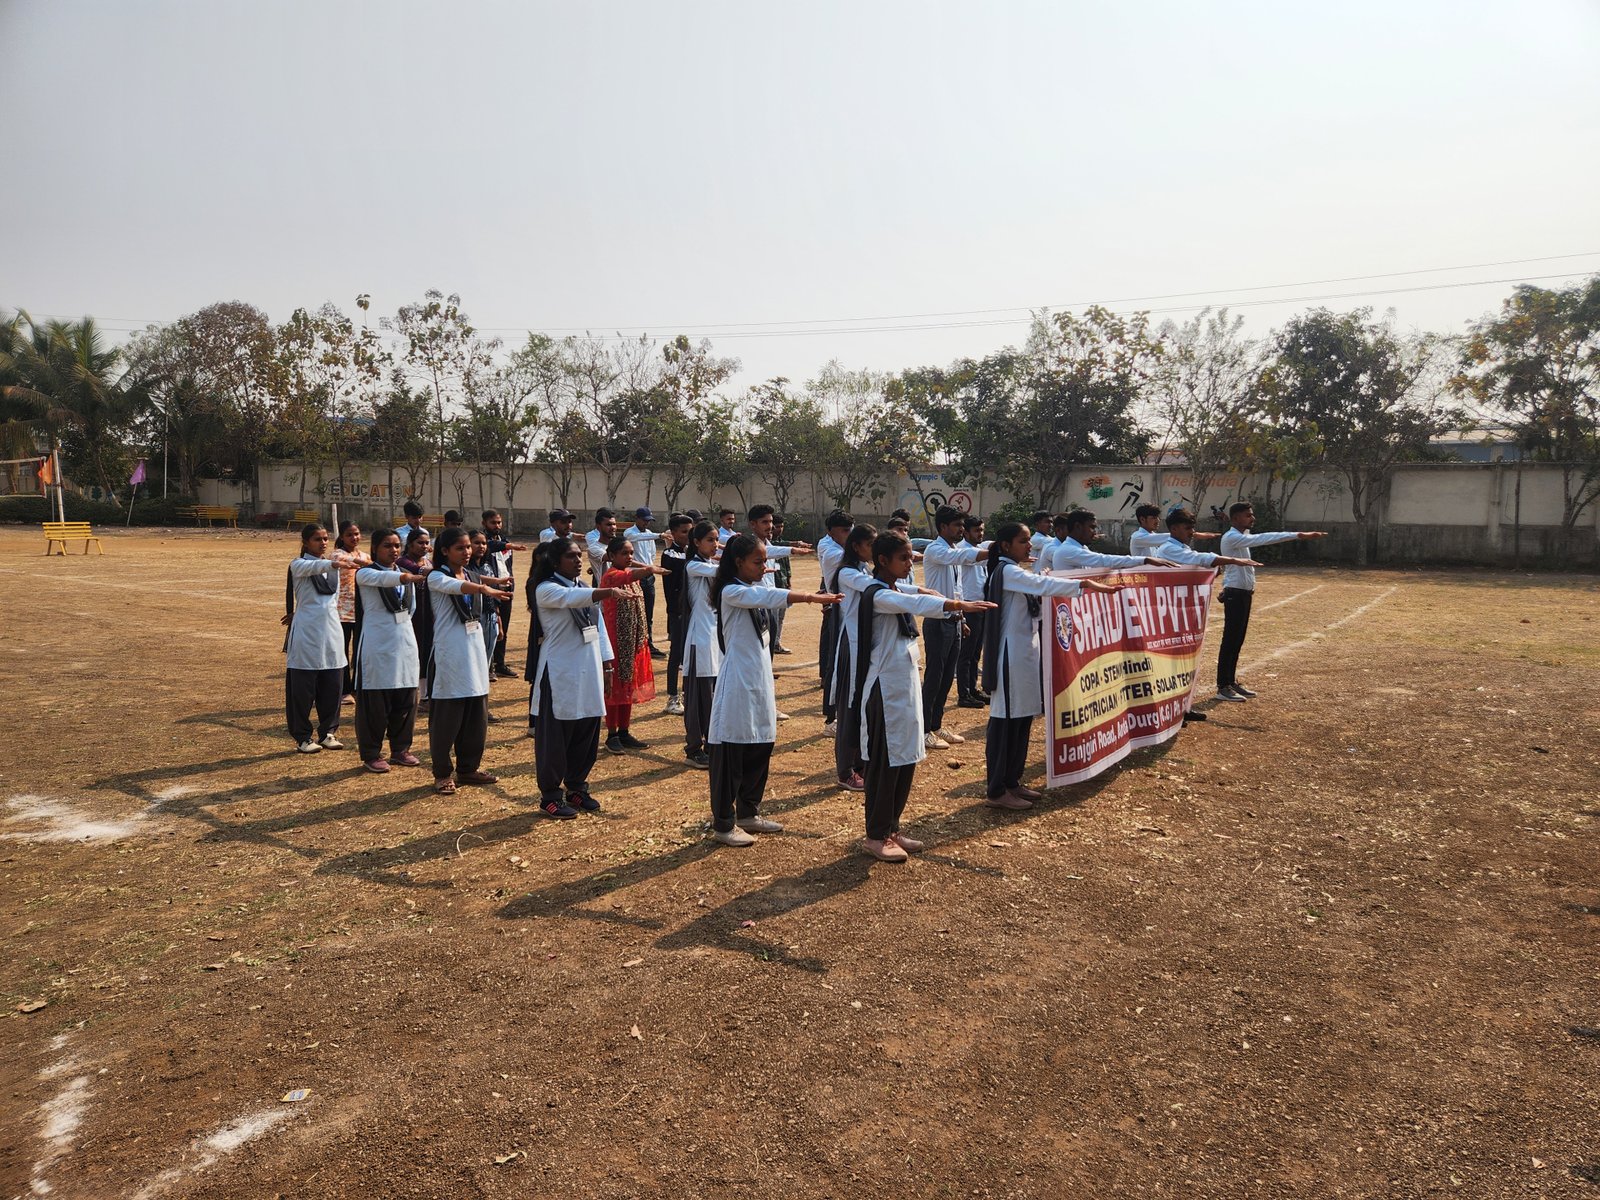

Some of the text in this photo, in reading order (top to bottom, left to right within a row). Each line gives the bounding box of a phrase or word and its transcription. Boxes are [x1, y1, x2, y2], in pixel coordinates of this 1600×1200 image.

[331, 484, 413, 498] EDUCATON
[1163, 473, 1238, 487] Khel ndia
[1156, 586, 1189, 634] PVT
[1080, 671, 1100, 693] COPA
[1061, 692, 1119, 729] ELECTRICIAN
[1156, 674, 1178, 694] SOLAR
[1059, 733, 1098, 764] Janjgiri
[1127, 711, 1160, 729] Durg
